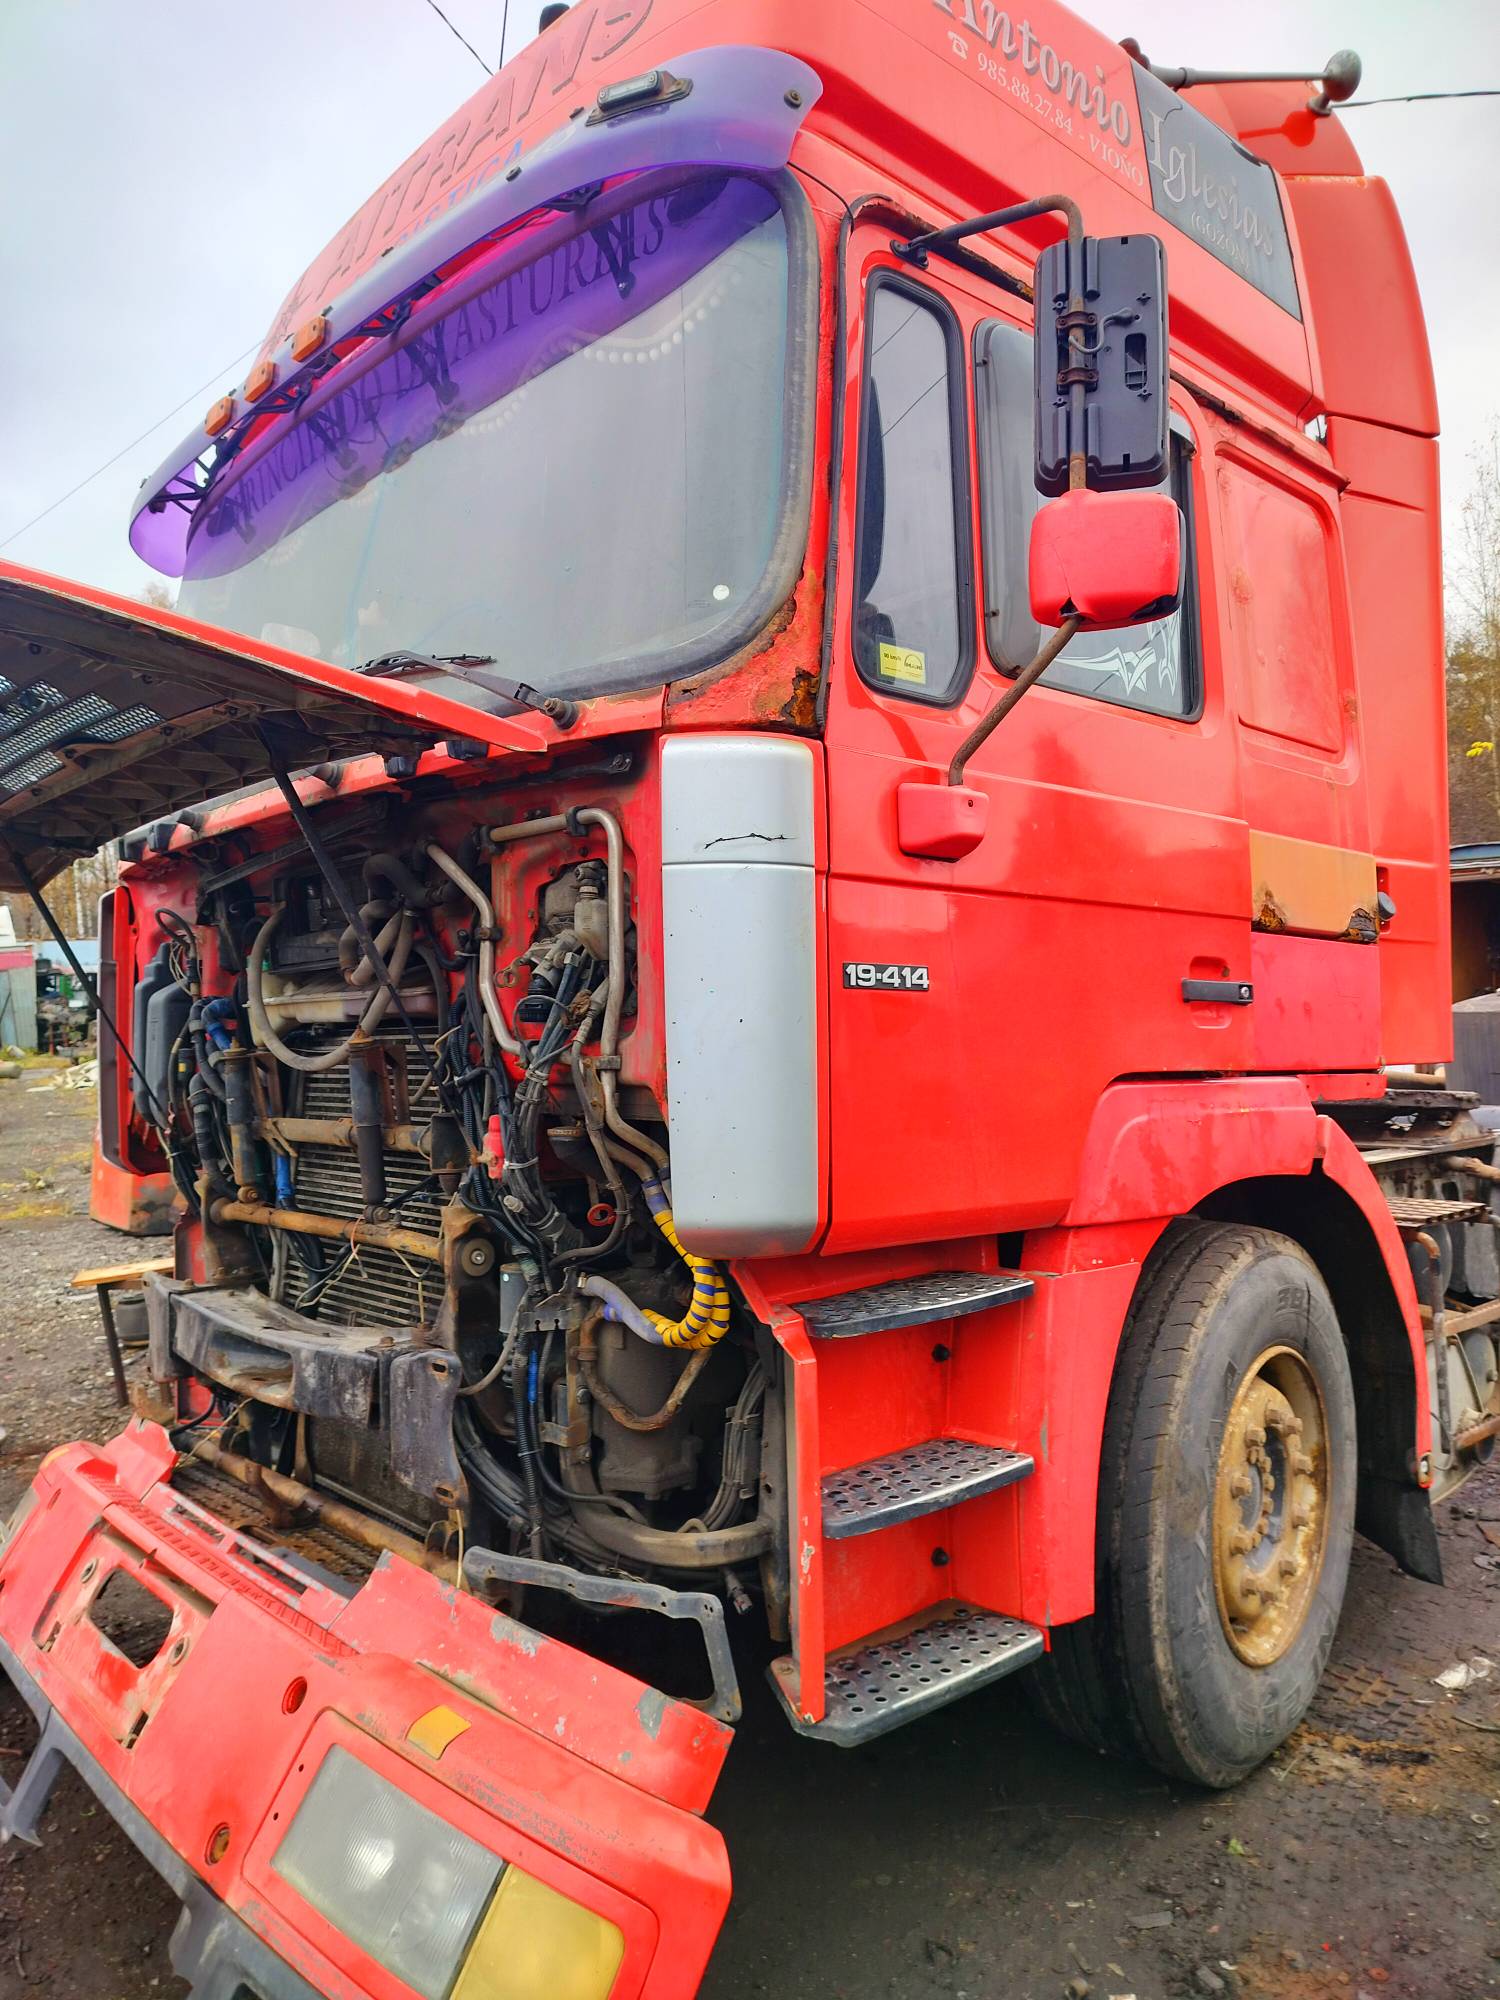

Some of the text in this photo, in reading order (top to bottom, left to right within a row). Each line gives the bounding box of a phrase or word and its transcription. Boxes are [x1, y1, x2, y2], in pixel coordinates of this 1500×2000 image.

[977, 52, 1073, 136] 985.88.27.84
[1089, 133, 1144, 187] VIOÑO
[1147, 105, 1273, 256] Iglesias
